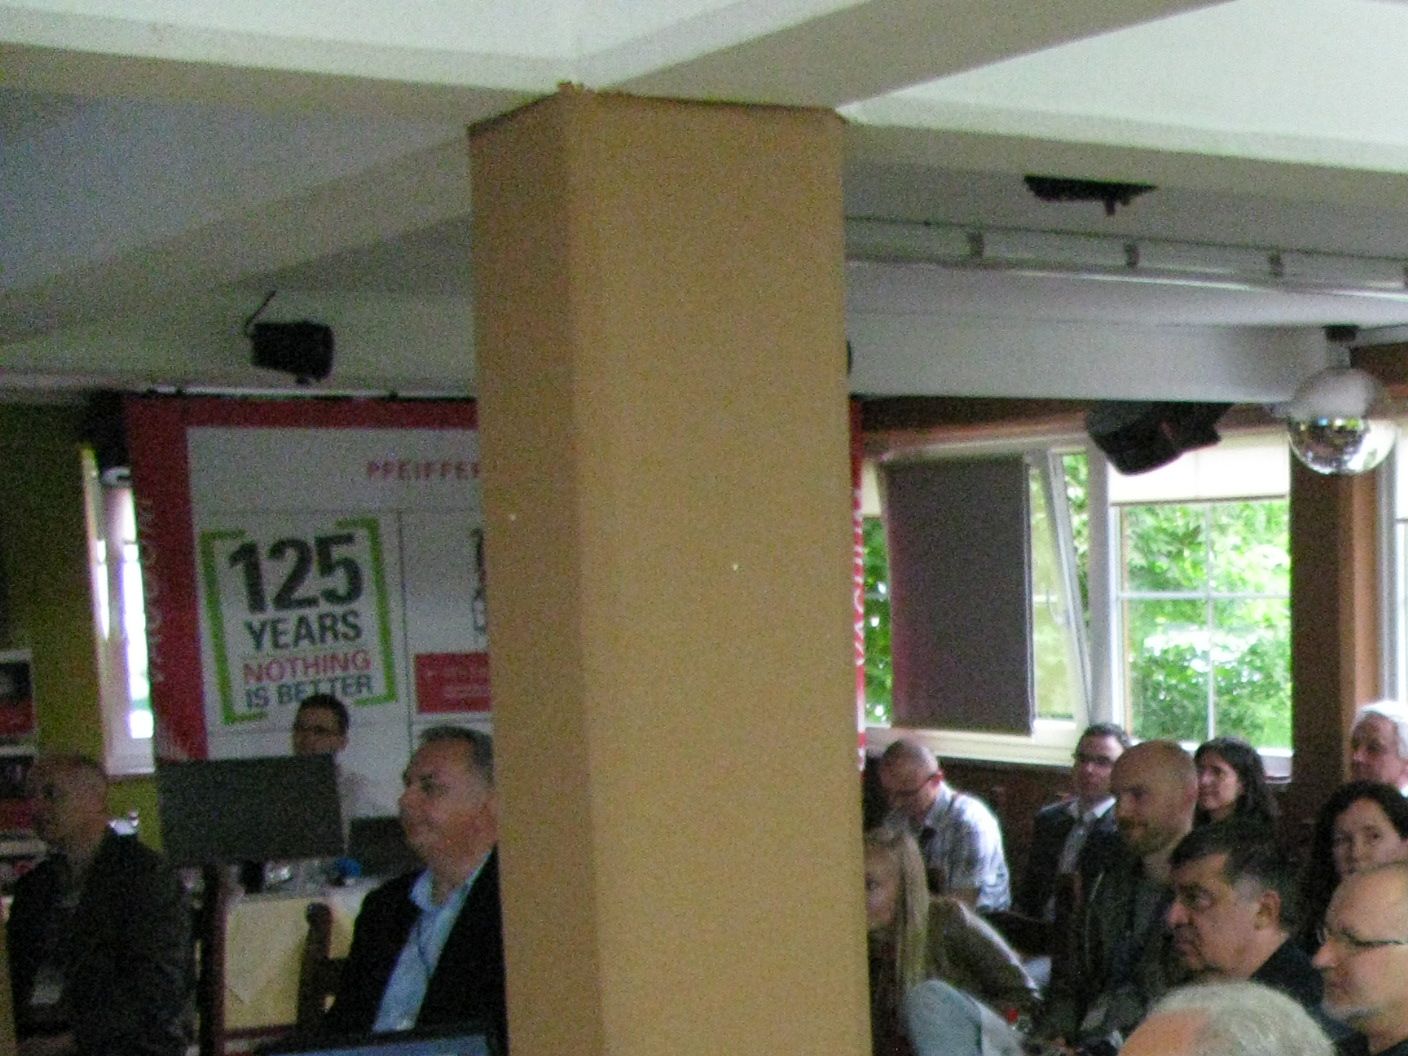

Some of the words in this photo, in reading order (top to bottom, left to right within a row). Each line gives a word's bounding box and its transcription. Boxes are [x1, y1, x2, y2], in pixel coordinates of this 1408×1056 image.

[228, 532, 363, 614] 125
[244, 609, 363, 650] YEARS
[243, 651, 372, 683] NOTHING
[245, 685, 270, 710] IS
[276, 673, 374, 704] BETTER
